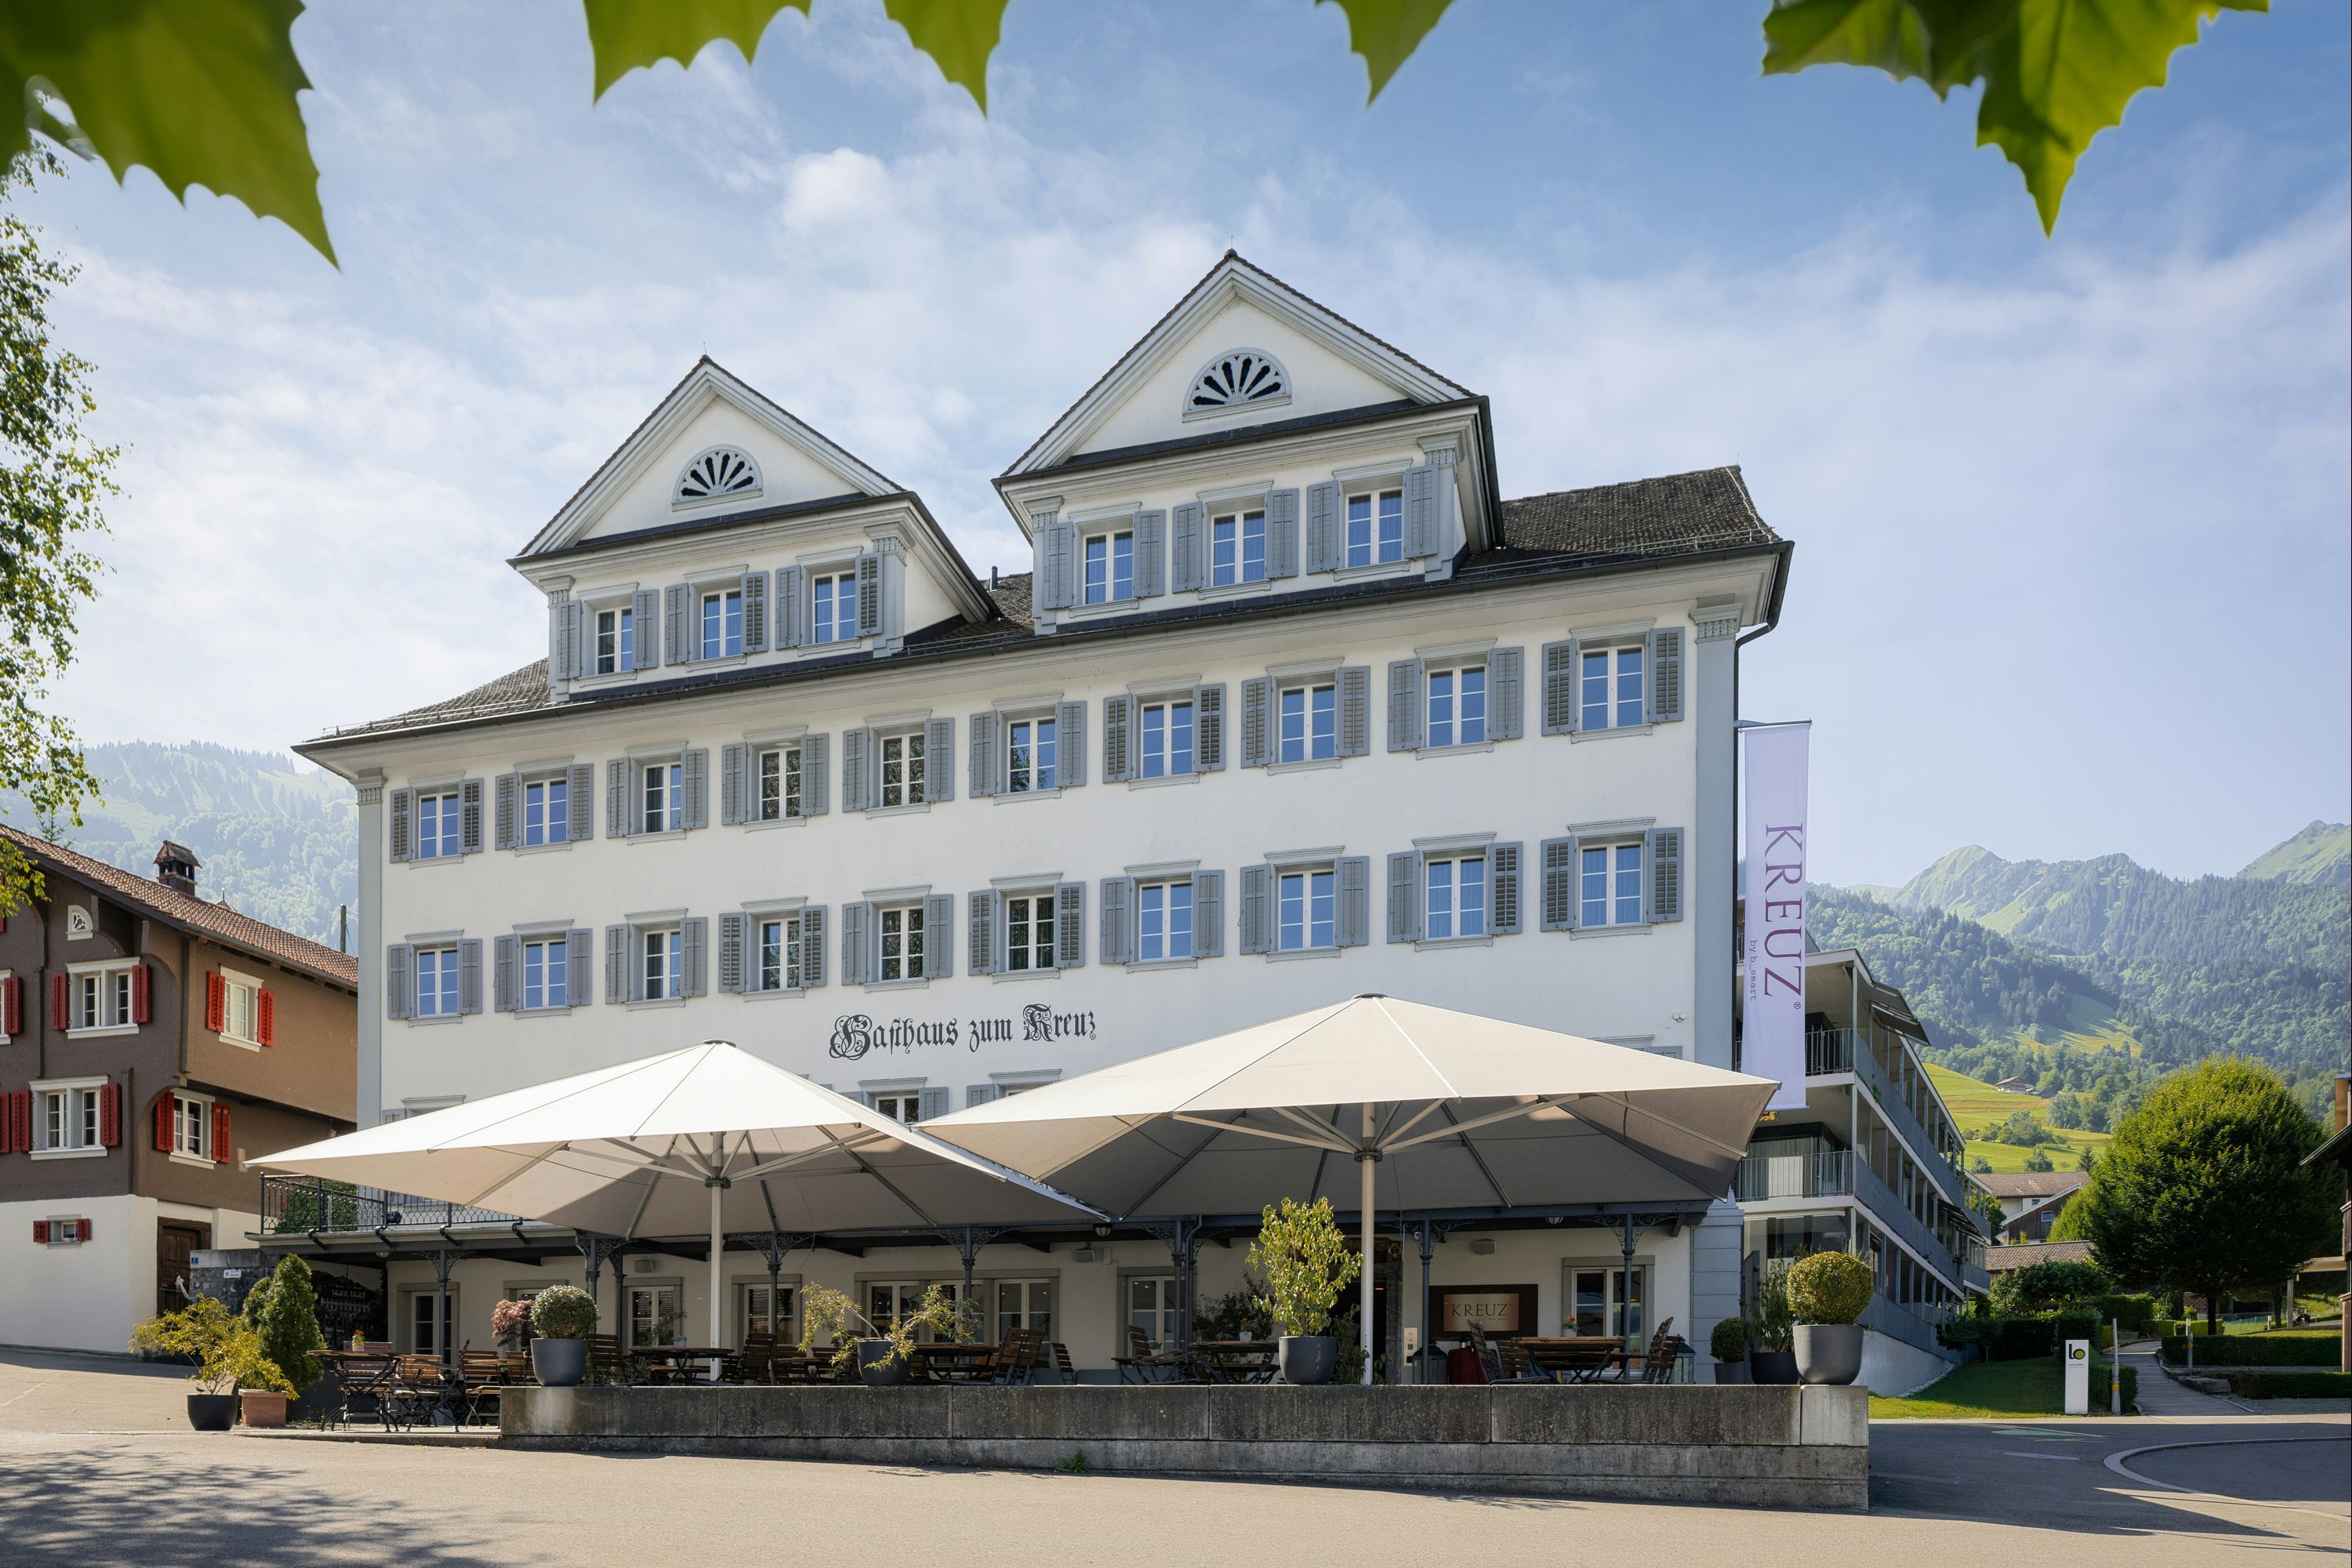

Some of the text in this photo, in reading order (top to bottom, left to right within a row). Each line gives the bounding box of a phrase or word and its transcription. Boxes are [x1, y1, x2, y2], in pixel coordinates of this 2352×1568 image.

[1749, 940, 1758, 1002] by b_smart
[967, 1018, 1013, 1052] zum
[1022, 1003, 1096, 1043] Kreuz
